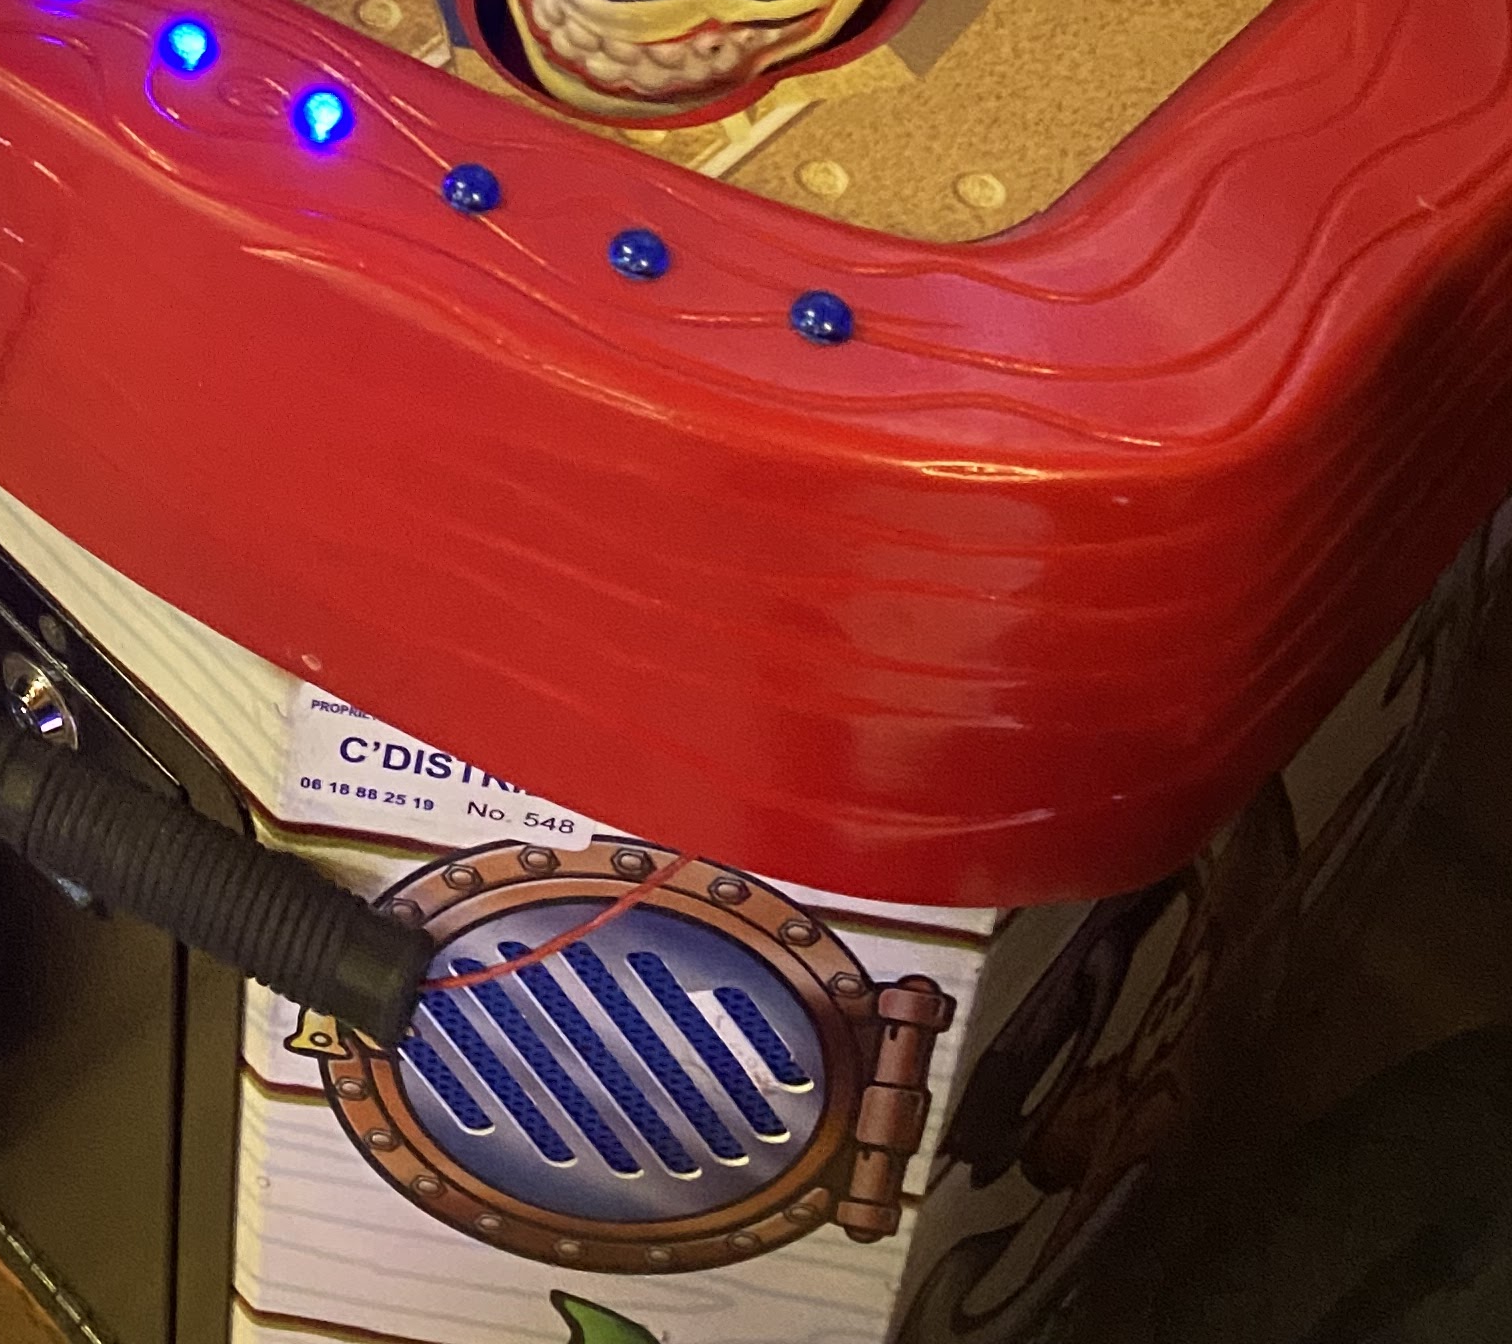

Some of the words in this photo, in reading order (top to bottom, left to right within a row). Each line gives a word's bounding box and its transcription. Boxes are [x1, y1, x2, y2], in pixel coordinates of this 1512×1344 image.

[329, 782, 350, 795] 18
[356, 786, 378, 800] 88
[383, 792, 407, 805] 25
[413, 797, 434, 811] 19
[523, 812, 575, 834] 548
